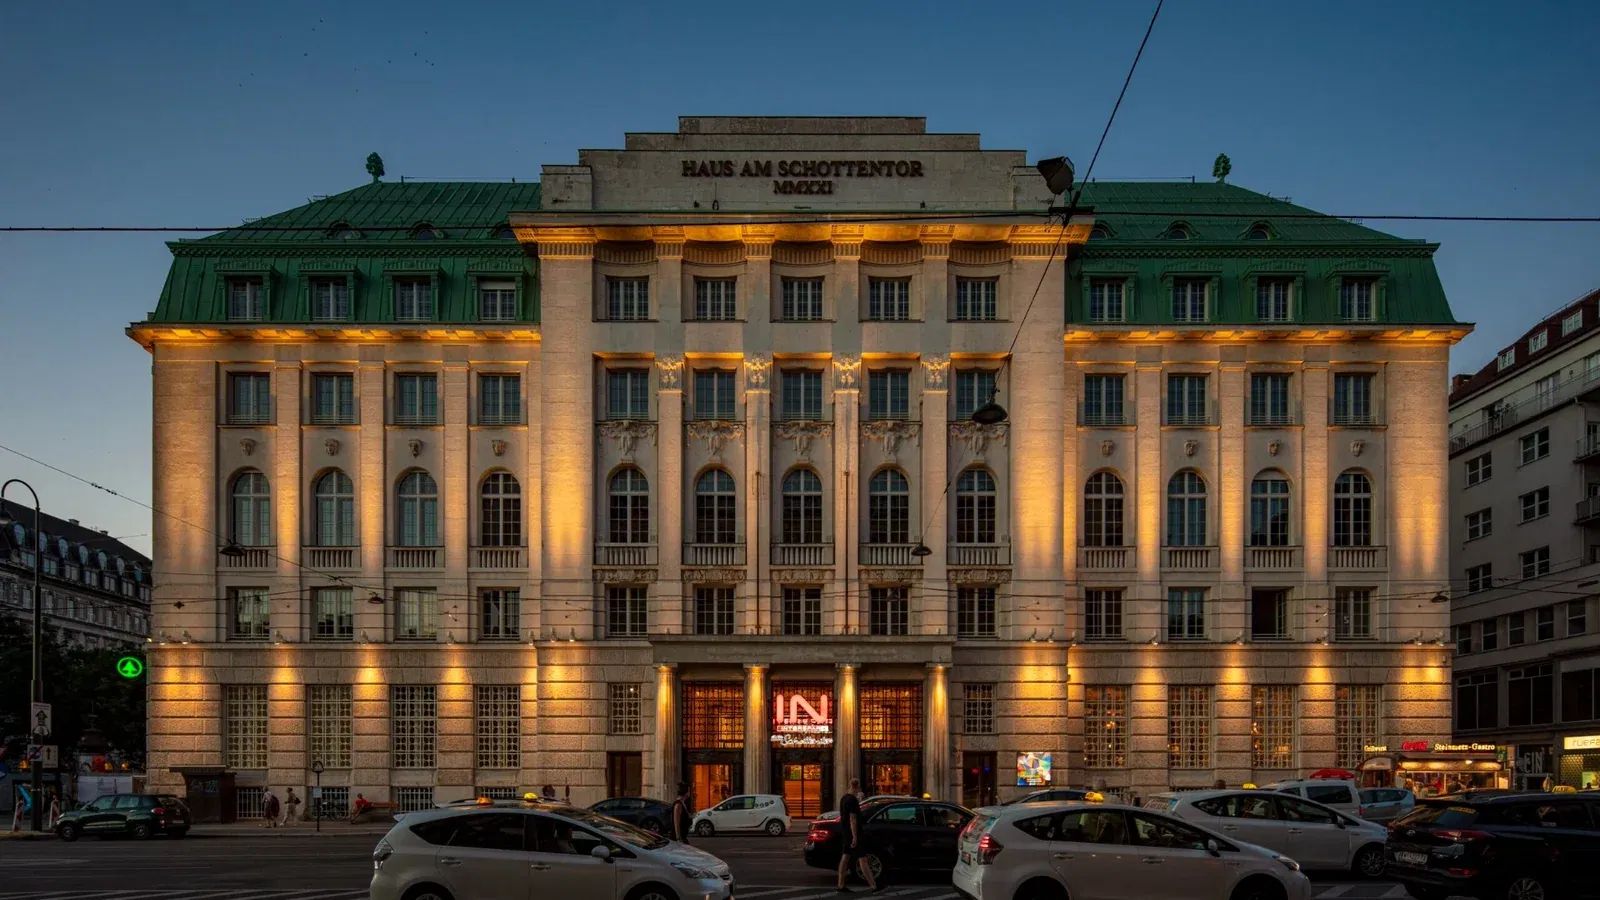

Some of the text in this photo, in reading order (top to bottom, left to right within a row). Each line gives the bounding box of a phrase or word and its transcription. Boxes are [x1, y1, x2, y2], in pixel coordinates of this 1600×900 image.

[681, 160, 924, 177] HAUS AM SCHOTTENTOR
[773, 180, 833, 195] MMXXI
[776, 694, 828, 724] IN
[1434, 743, 1496, 751] Steinmetz-Gastro
